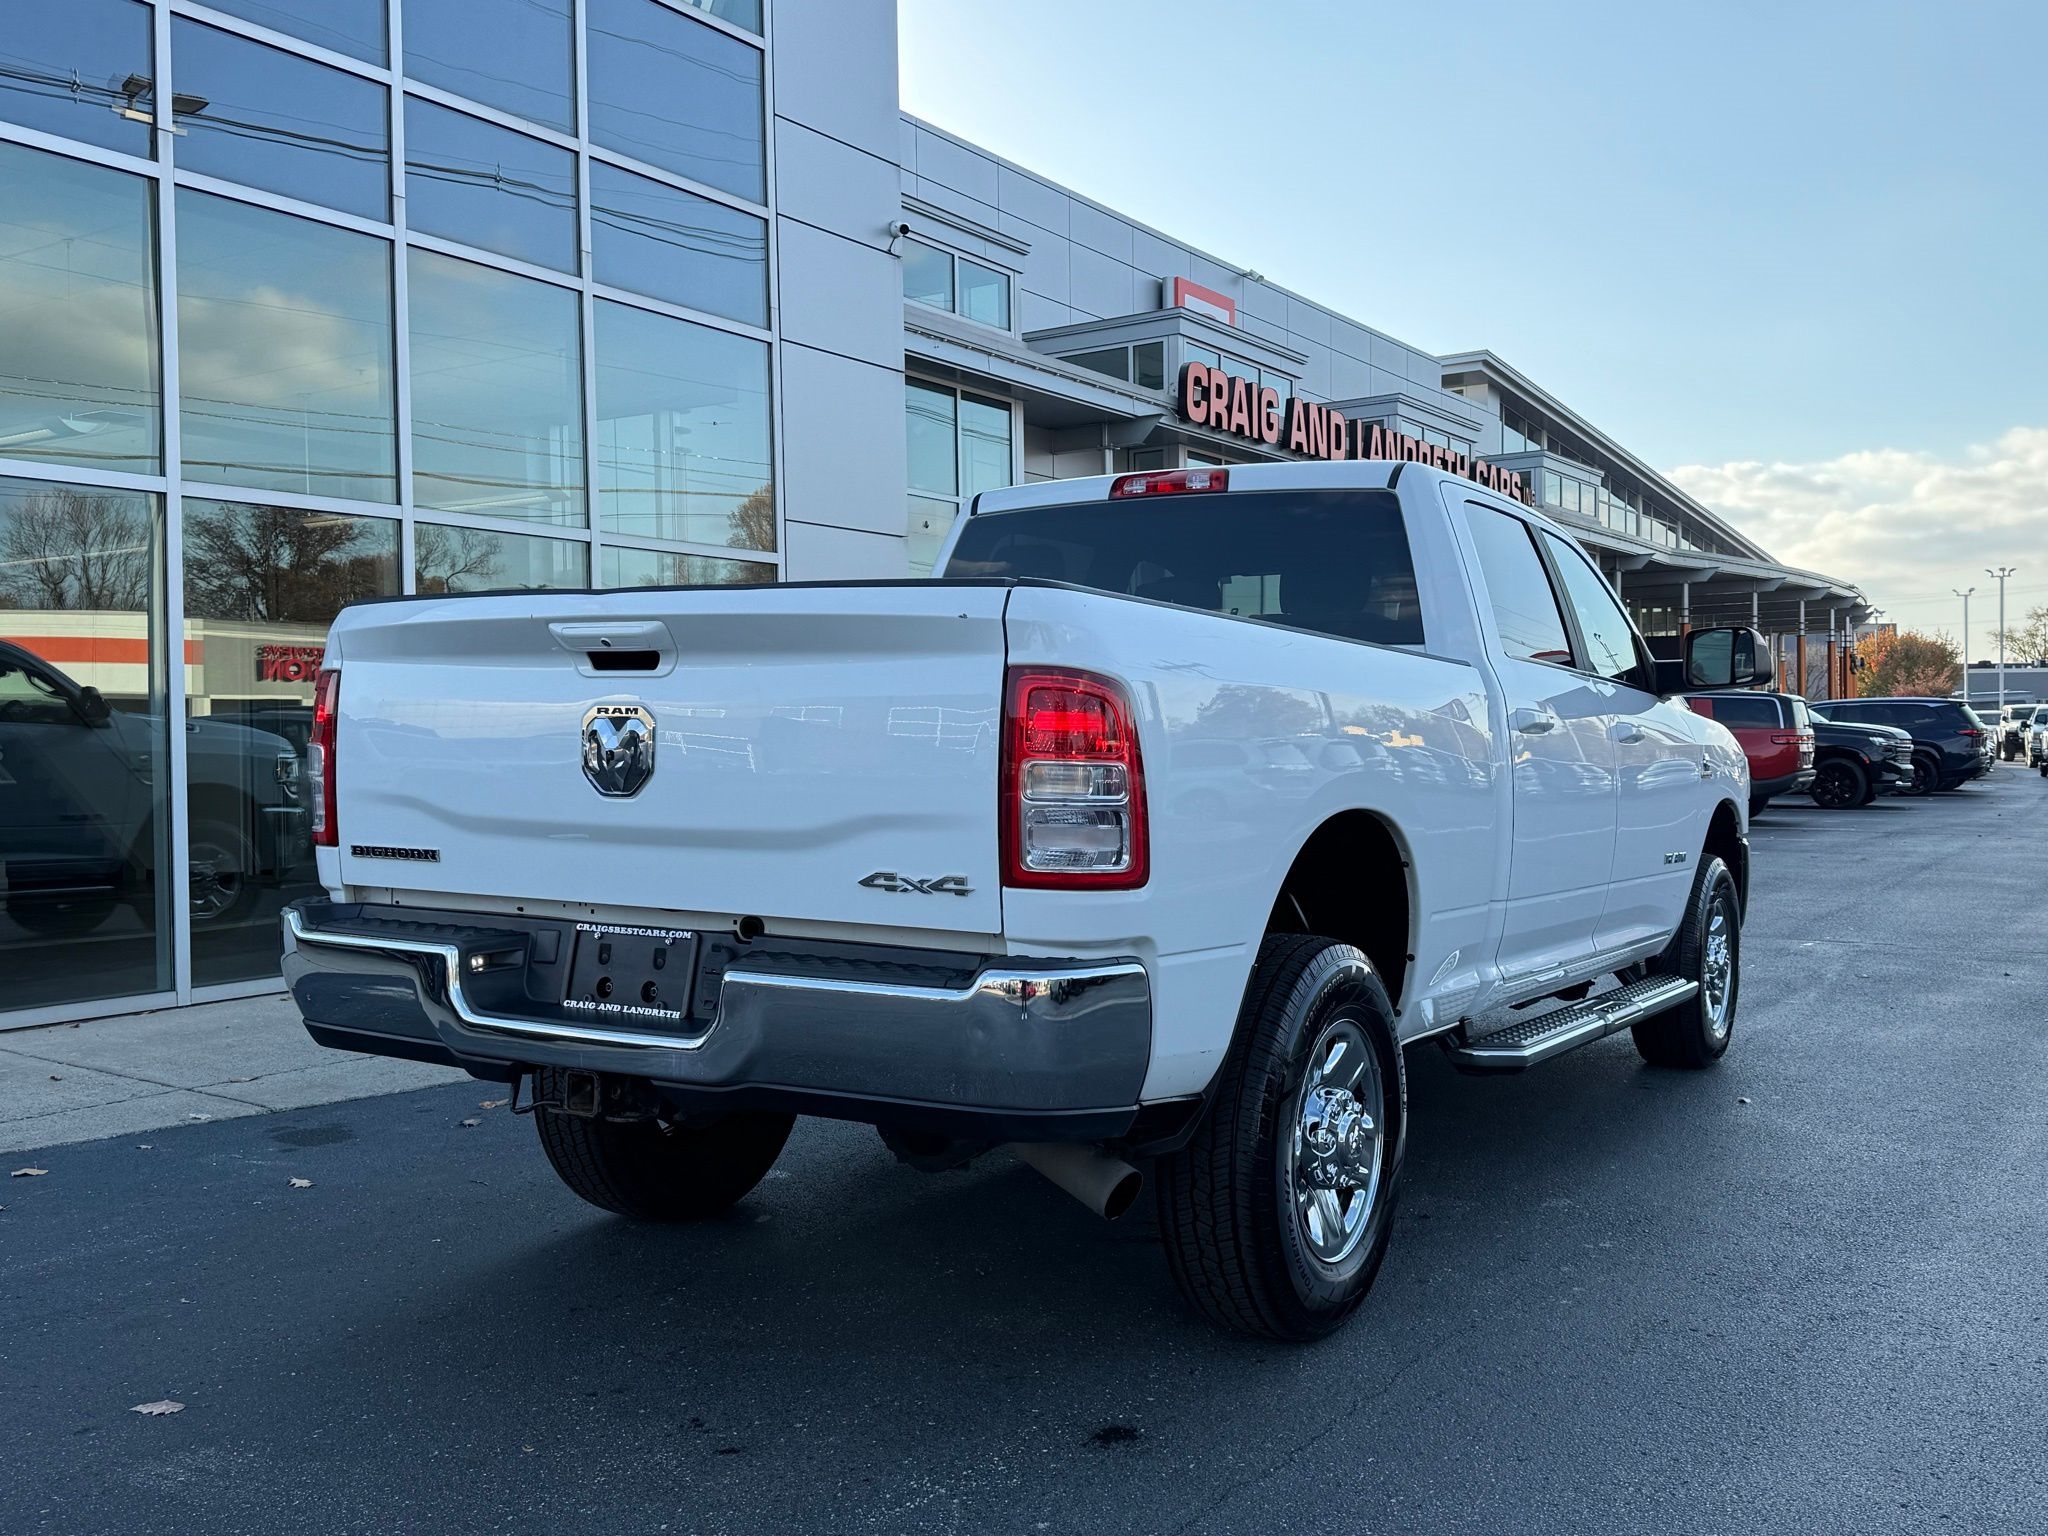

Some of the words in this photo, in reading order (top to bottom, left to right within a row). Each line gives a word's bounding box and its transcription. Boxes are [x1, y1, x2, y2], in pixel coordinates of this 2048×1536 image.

[1180, 361, 1280, 444] CRAIG
[1286, 397, 1347, 461] AND
[596, 707, 640, 716] RAM
[350, 844, 441, 863] BIGHORN
[576, 923, 693, 939] CRAIGSBESTCARS.COM
[563, 999, 597, 1010] CRAIG
[597, 1003, 621, 1013] AND
[622, 1005, 681, 1019] LANDRETH
[1286, 1211, 1315, 1294] TORMENTA
